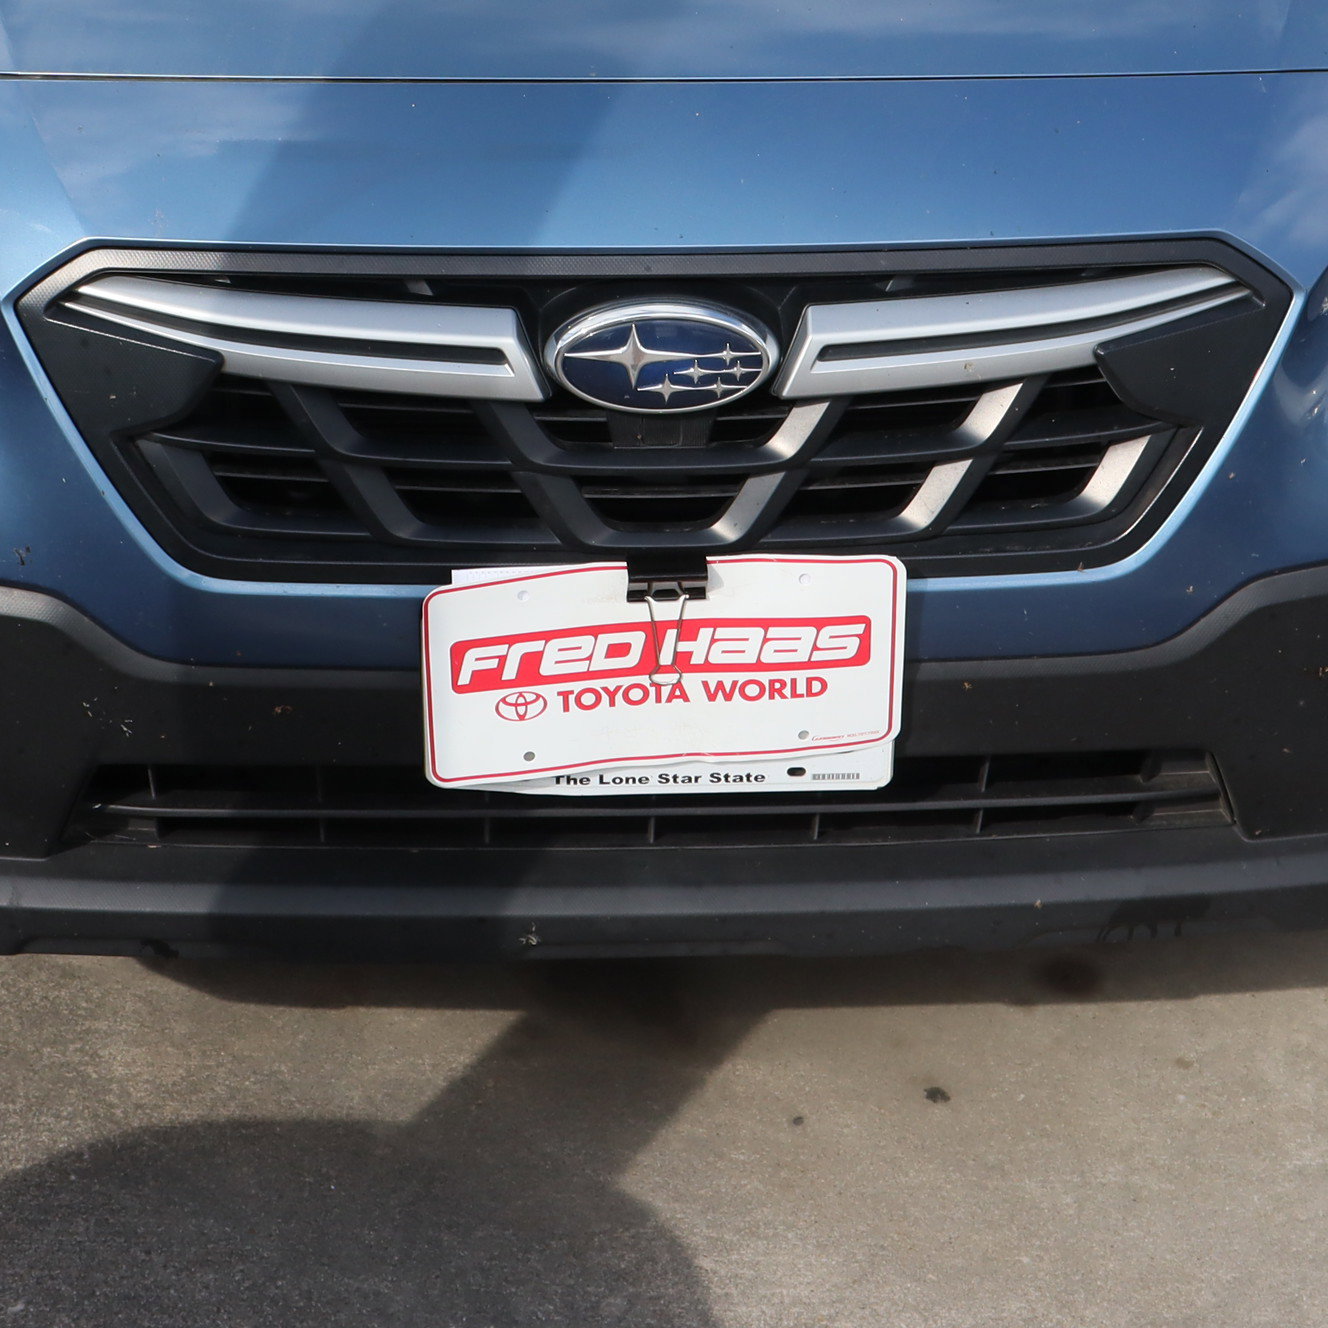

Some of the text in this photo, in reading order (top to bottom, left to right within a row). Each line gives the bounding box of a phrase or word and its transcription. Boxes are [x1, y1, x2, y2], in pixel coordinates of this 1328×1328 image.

[557, 676, 828, 713] TOYOTA WORLD
[554, 772, 766, 786] The Lone Star State
